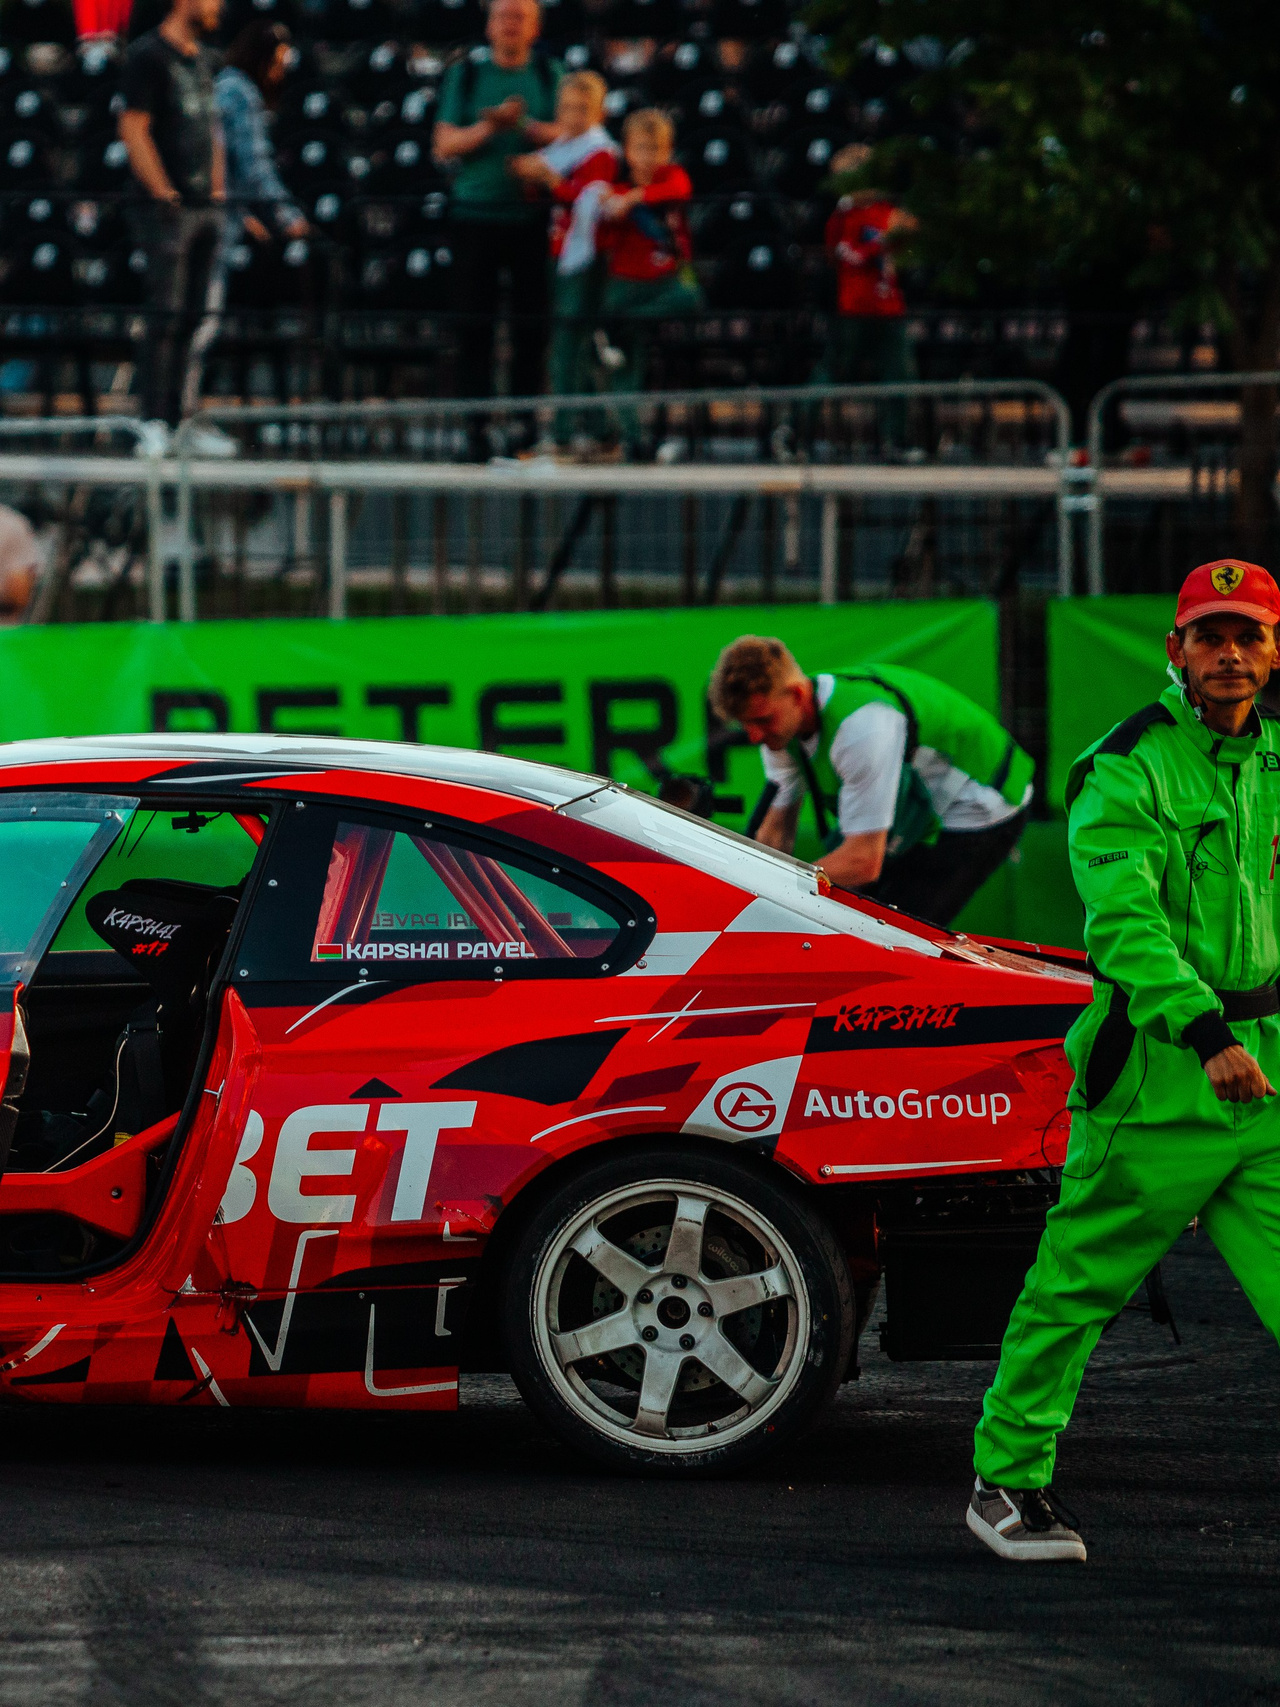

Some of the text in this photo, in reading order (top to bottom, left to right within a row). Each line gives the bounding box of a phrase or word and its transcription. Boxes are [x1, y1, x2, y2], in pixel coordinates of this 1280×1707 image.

[103, 907, 182, 940] KAPSHAI
[347, 942, 535, 960] KAPSHAI PAVEL
[833, 1002, 965, 1032] KAPSHAI
[803, 1089, 1011, 1125] AutoGroup
